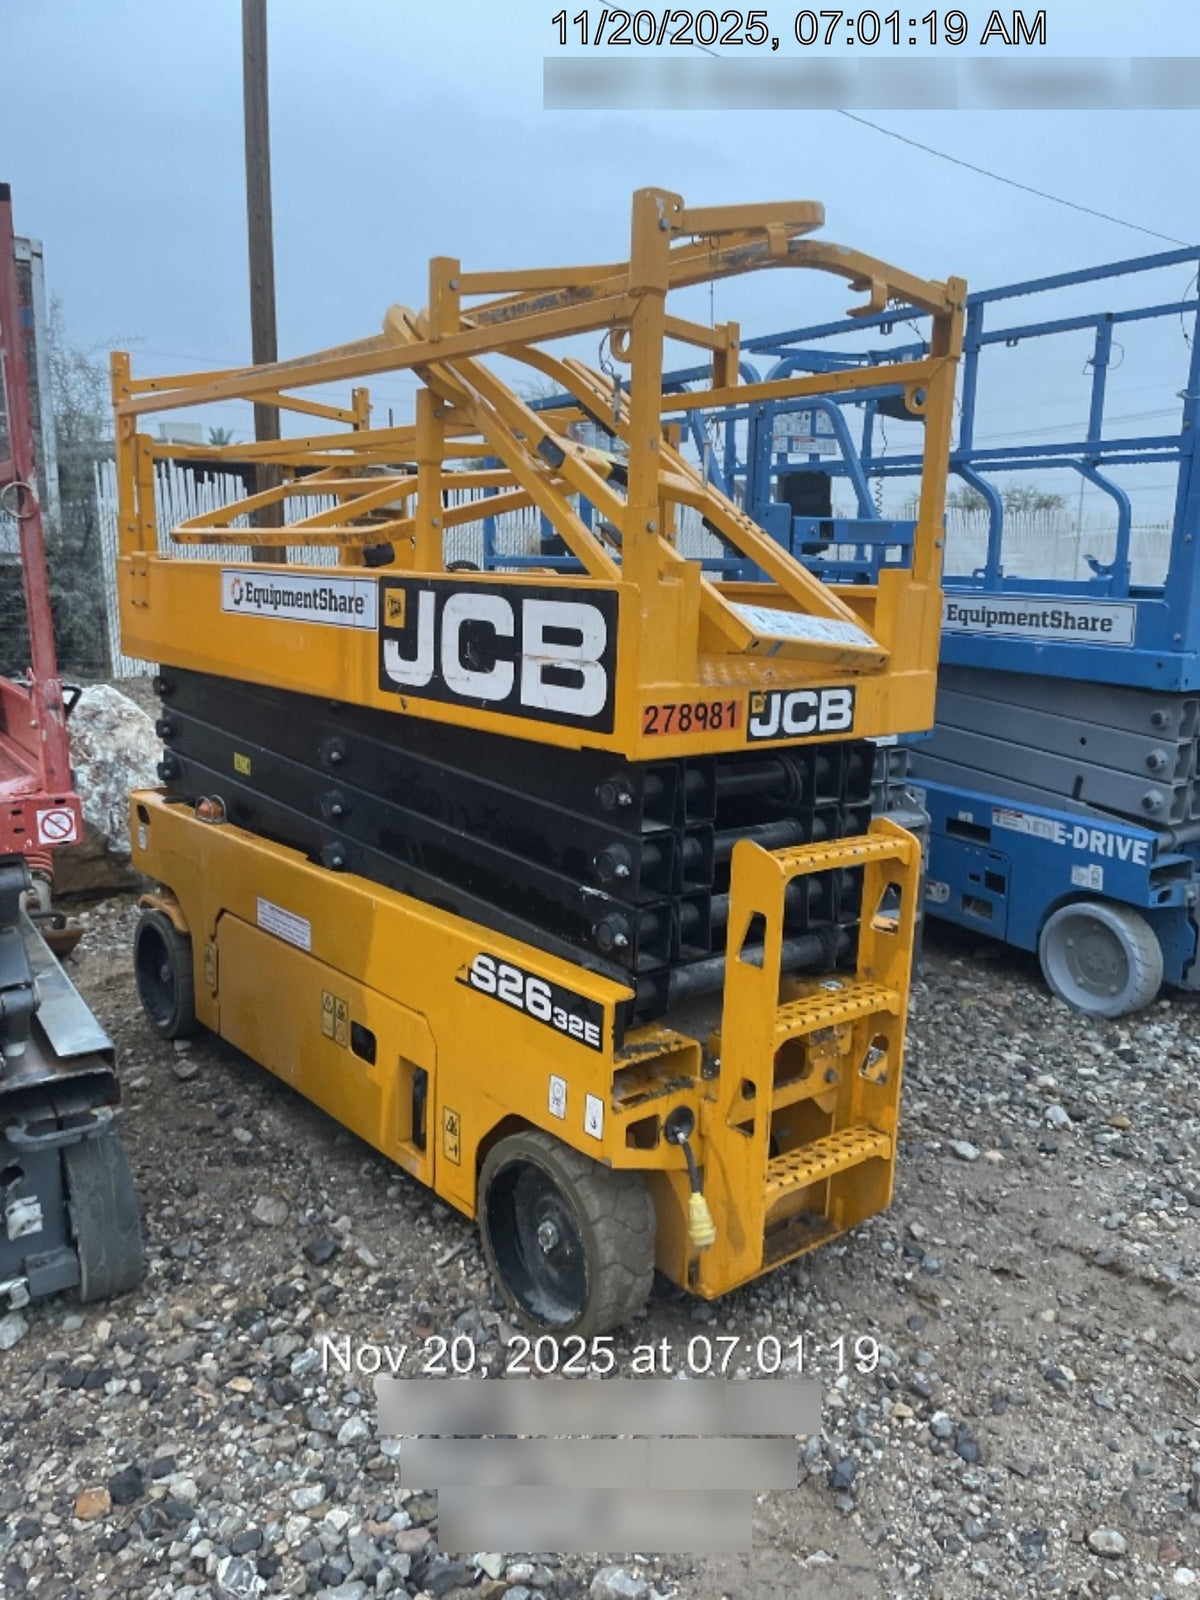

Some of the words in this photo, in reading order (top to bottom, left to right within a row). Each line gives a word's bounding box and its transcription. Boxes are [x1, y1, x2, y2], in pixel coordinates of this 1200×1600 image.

[245, 581, 364, 614] EquipmentShare
[947, 604, 1113, 632] EquipmentShare
[384, 590, 608, 718] JCB
[643, 700, 736, 735] 278981
[750, 688, 854, 738] JCB
[1053, 821, 1149, 866] E-DRIVE
